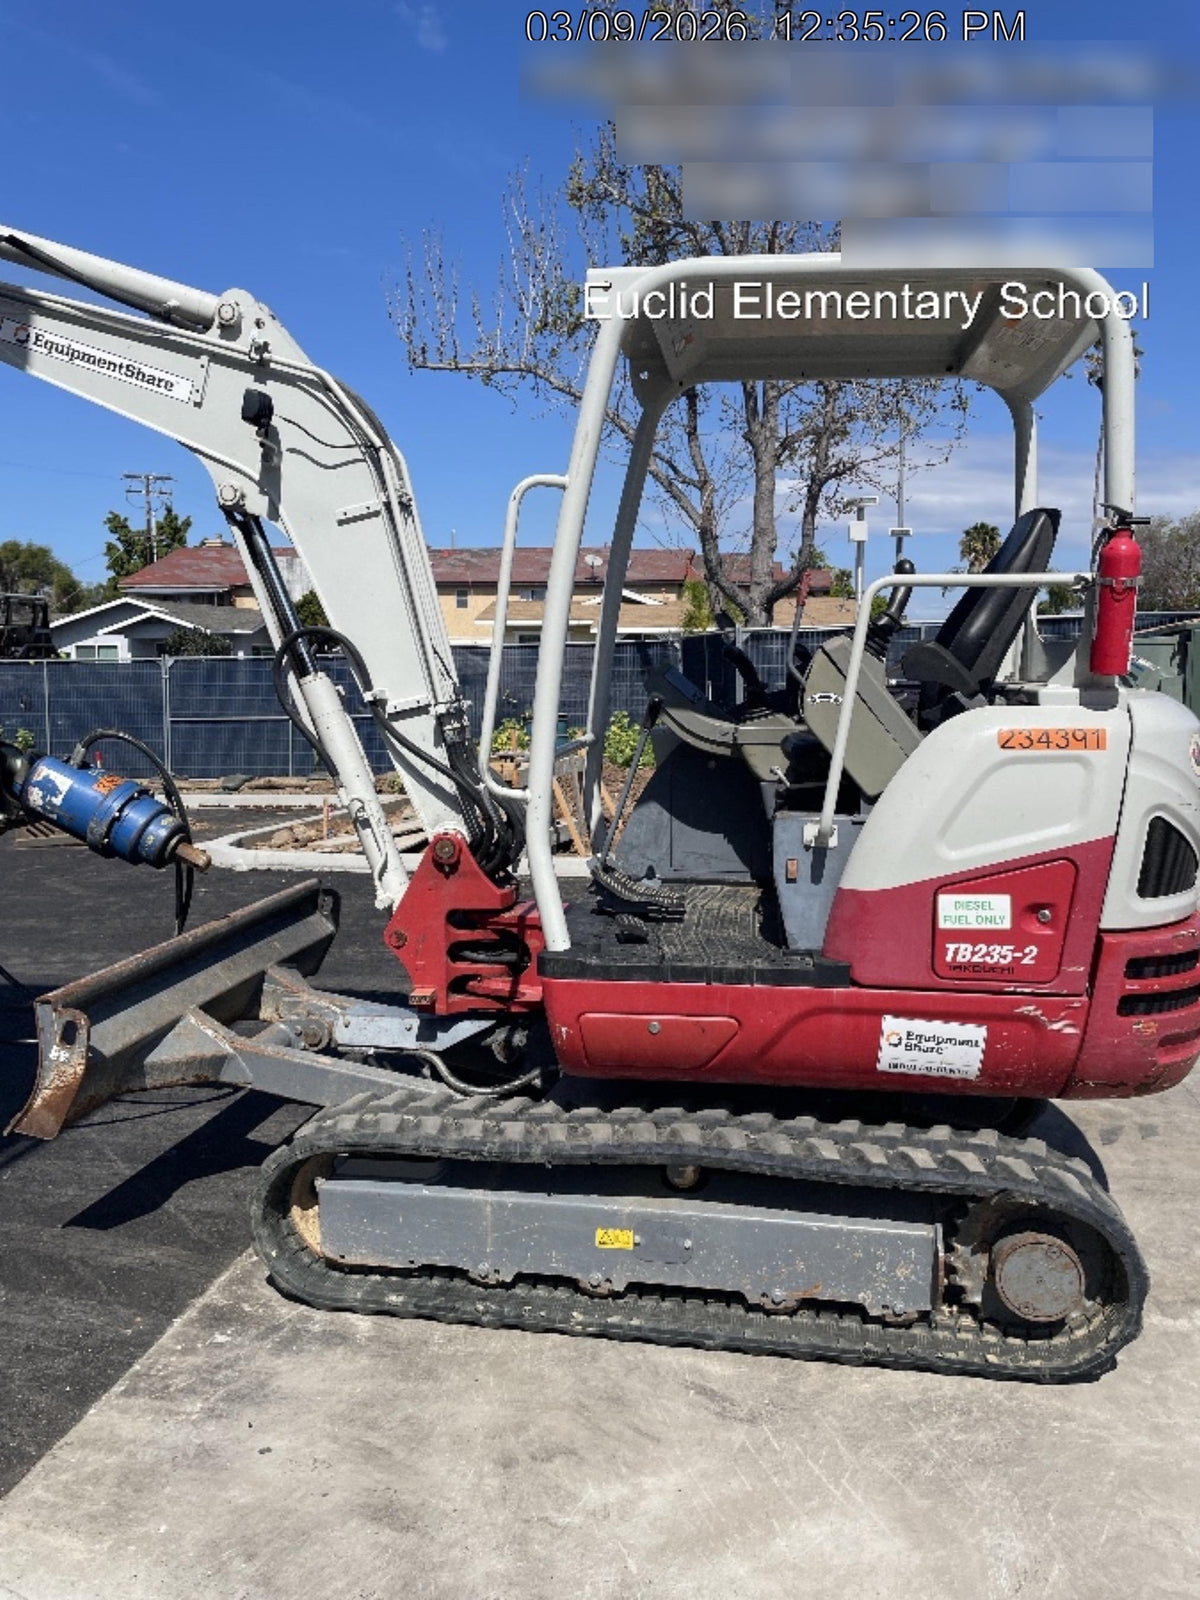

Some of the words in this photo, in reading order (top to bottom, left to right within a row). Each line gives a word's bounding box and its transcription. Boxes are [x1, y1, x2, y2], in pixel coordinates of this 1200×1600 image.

[33, 331, 175, 392] EquipmentShare
[999, 729, 1101, 749] 234391
[954, 900, 995, 911] DIESEL
[943, 915, 972, 925] FUEL
[976, 915, 1006, 925] ONLY
[945, 943, 1039, 965] TB235-2
